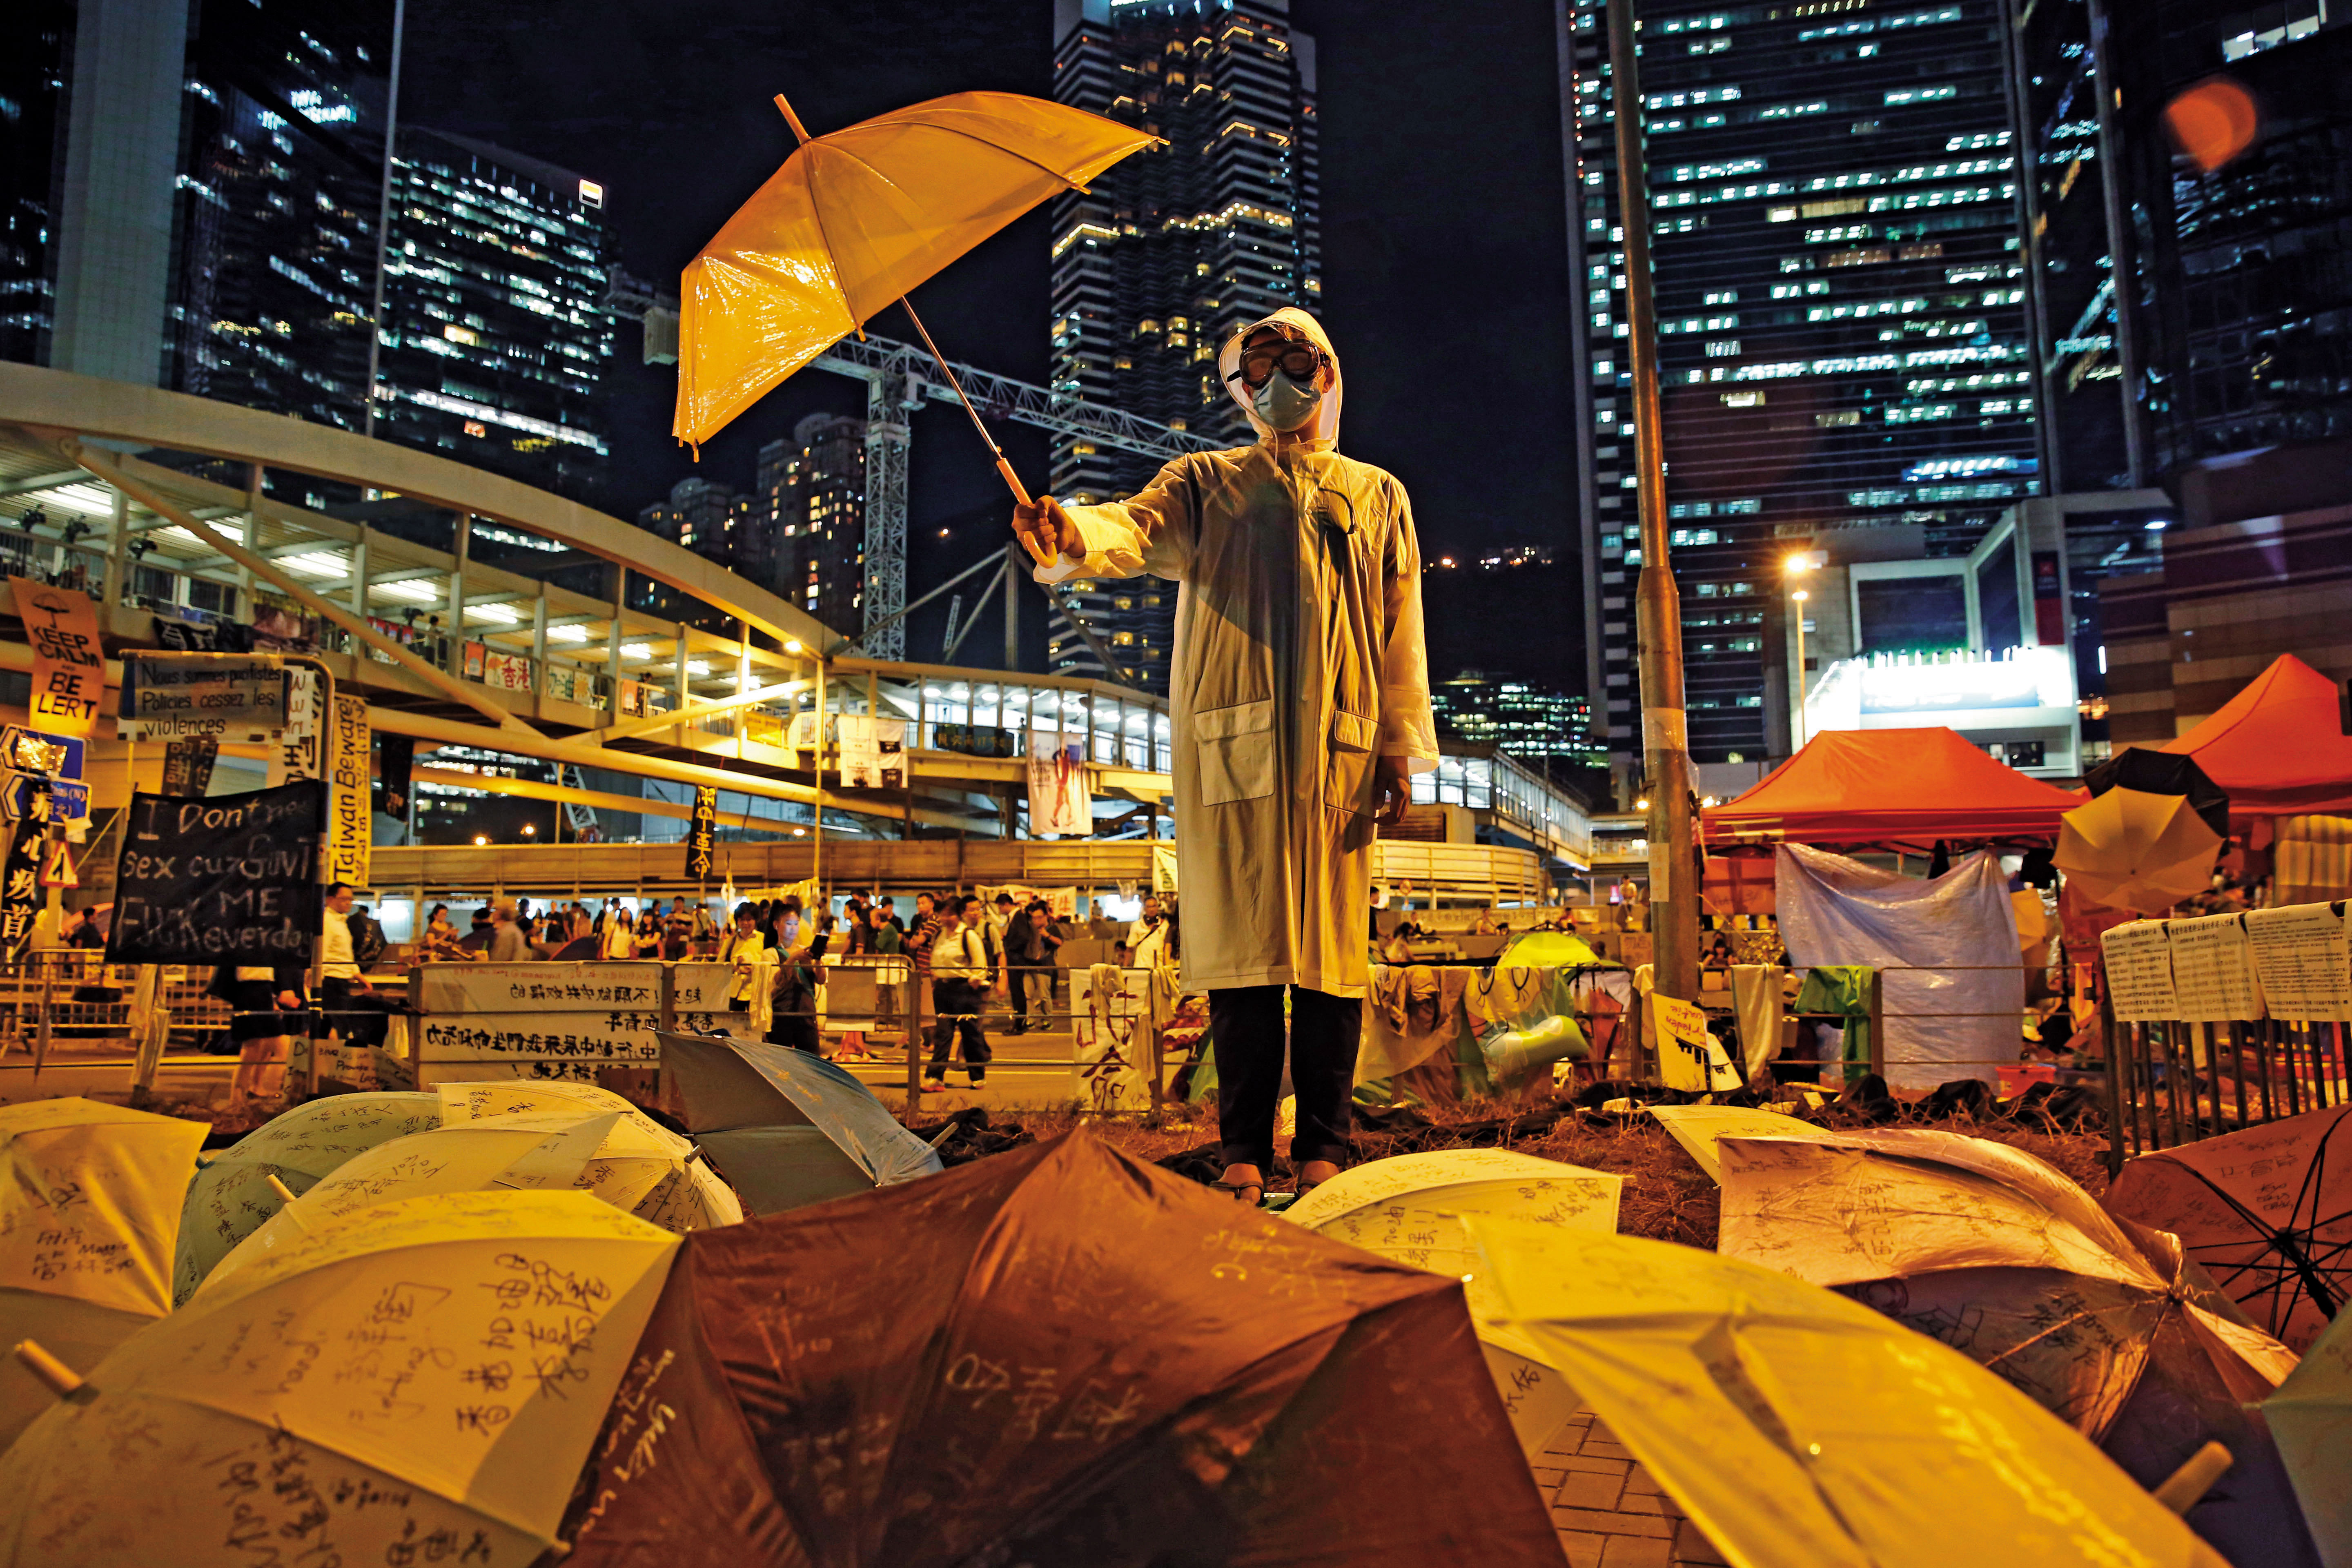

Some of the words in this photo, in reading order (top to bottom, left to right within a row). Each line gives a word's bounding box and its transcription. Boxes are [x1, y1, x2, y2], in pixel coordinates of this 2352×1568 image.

[29, 623, 89, 649] KEEP
[38, 642, 100, 668] CALM
[48, 671, 83, 695] BE
[141, 663, 179, 686] Nous
[184, 669, 227, 684] sommes
[502, 655, 530, 689] 香港
[38, 694, 97, 719] LERT
[200, 693, 244, 708] cessez
[253, 690, 276, 707] les
[145, 713, 226, 736] violences
[335, 696, 356, 790] Beware!
[137, 799, 160, 840] I
[334, 793, 356, 880] Taiwan
[122, 851, 176, 879] sex
[219, 887, 283, 918] ME
